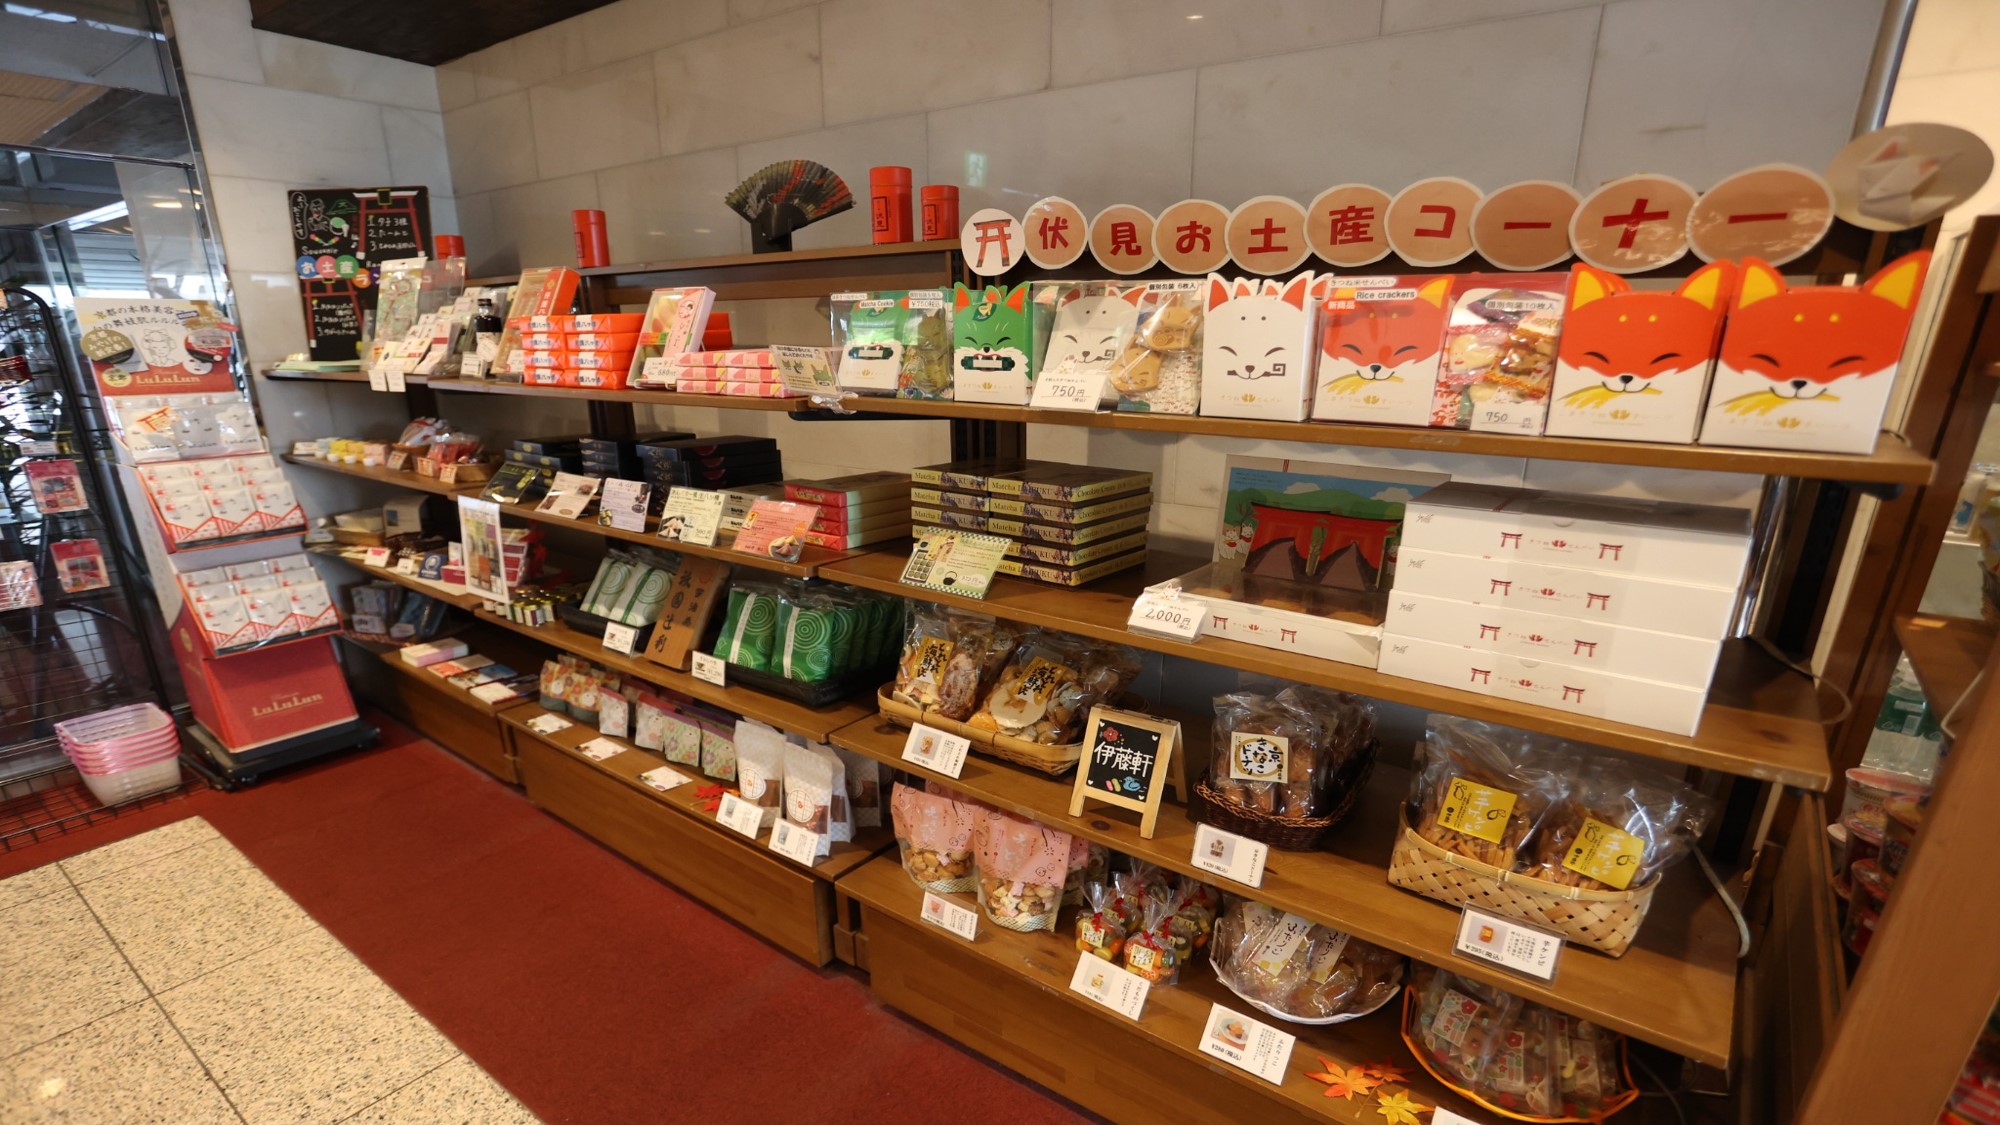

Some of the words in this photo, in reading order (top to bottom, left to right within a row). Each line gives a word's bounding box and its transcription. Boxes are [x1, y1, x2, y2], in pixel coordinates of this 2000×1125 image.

[1040, 198, 1787, 256] 伏見お土産コーナー
[1356, 291, 1375, 299] Rice
[1378, 290, 1415, 298] crackers
[1052, 385, 1085, 398] 750円
[1486, 411, 1508, 423] 750
[915, 472, 937, 481] Matcha
[992, 481, 1016, 491] Matcha
[915, 491, 937, 500] Matcha
[993, 502, 1017, 512] Matcha
[915, 510, 937, 519] Matcha
[992, 522, 1017, 532] Matcha
[1145, 607, 1191, 626] 2,000円
[252, 694, 323, 717] LuLuLun
[1094, 741, 1154, 777] 伊藤軒
